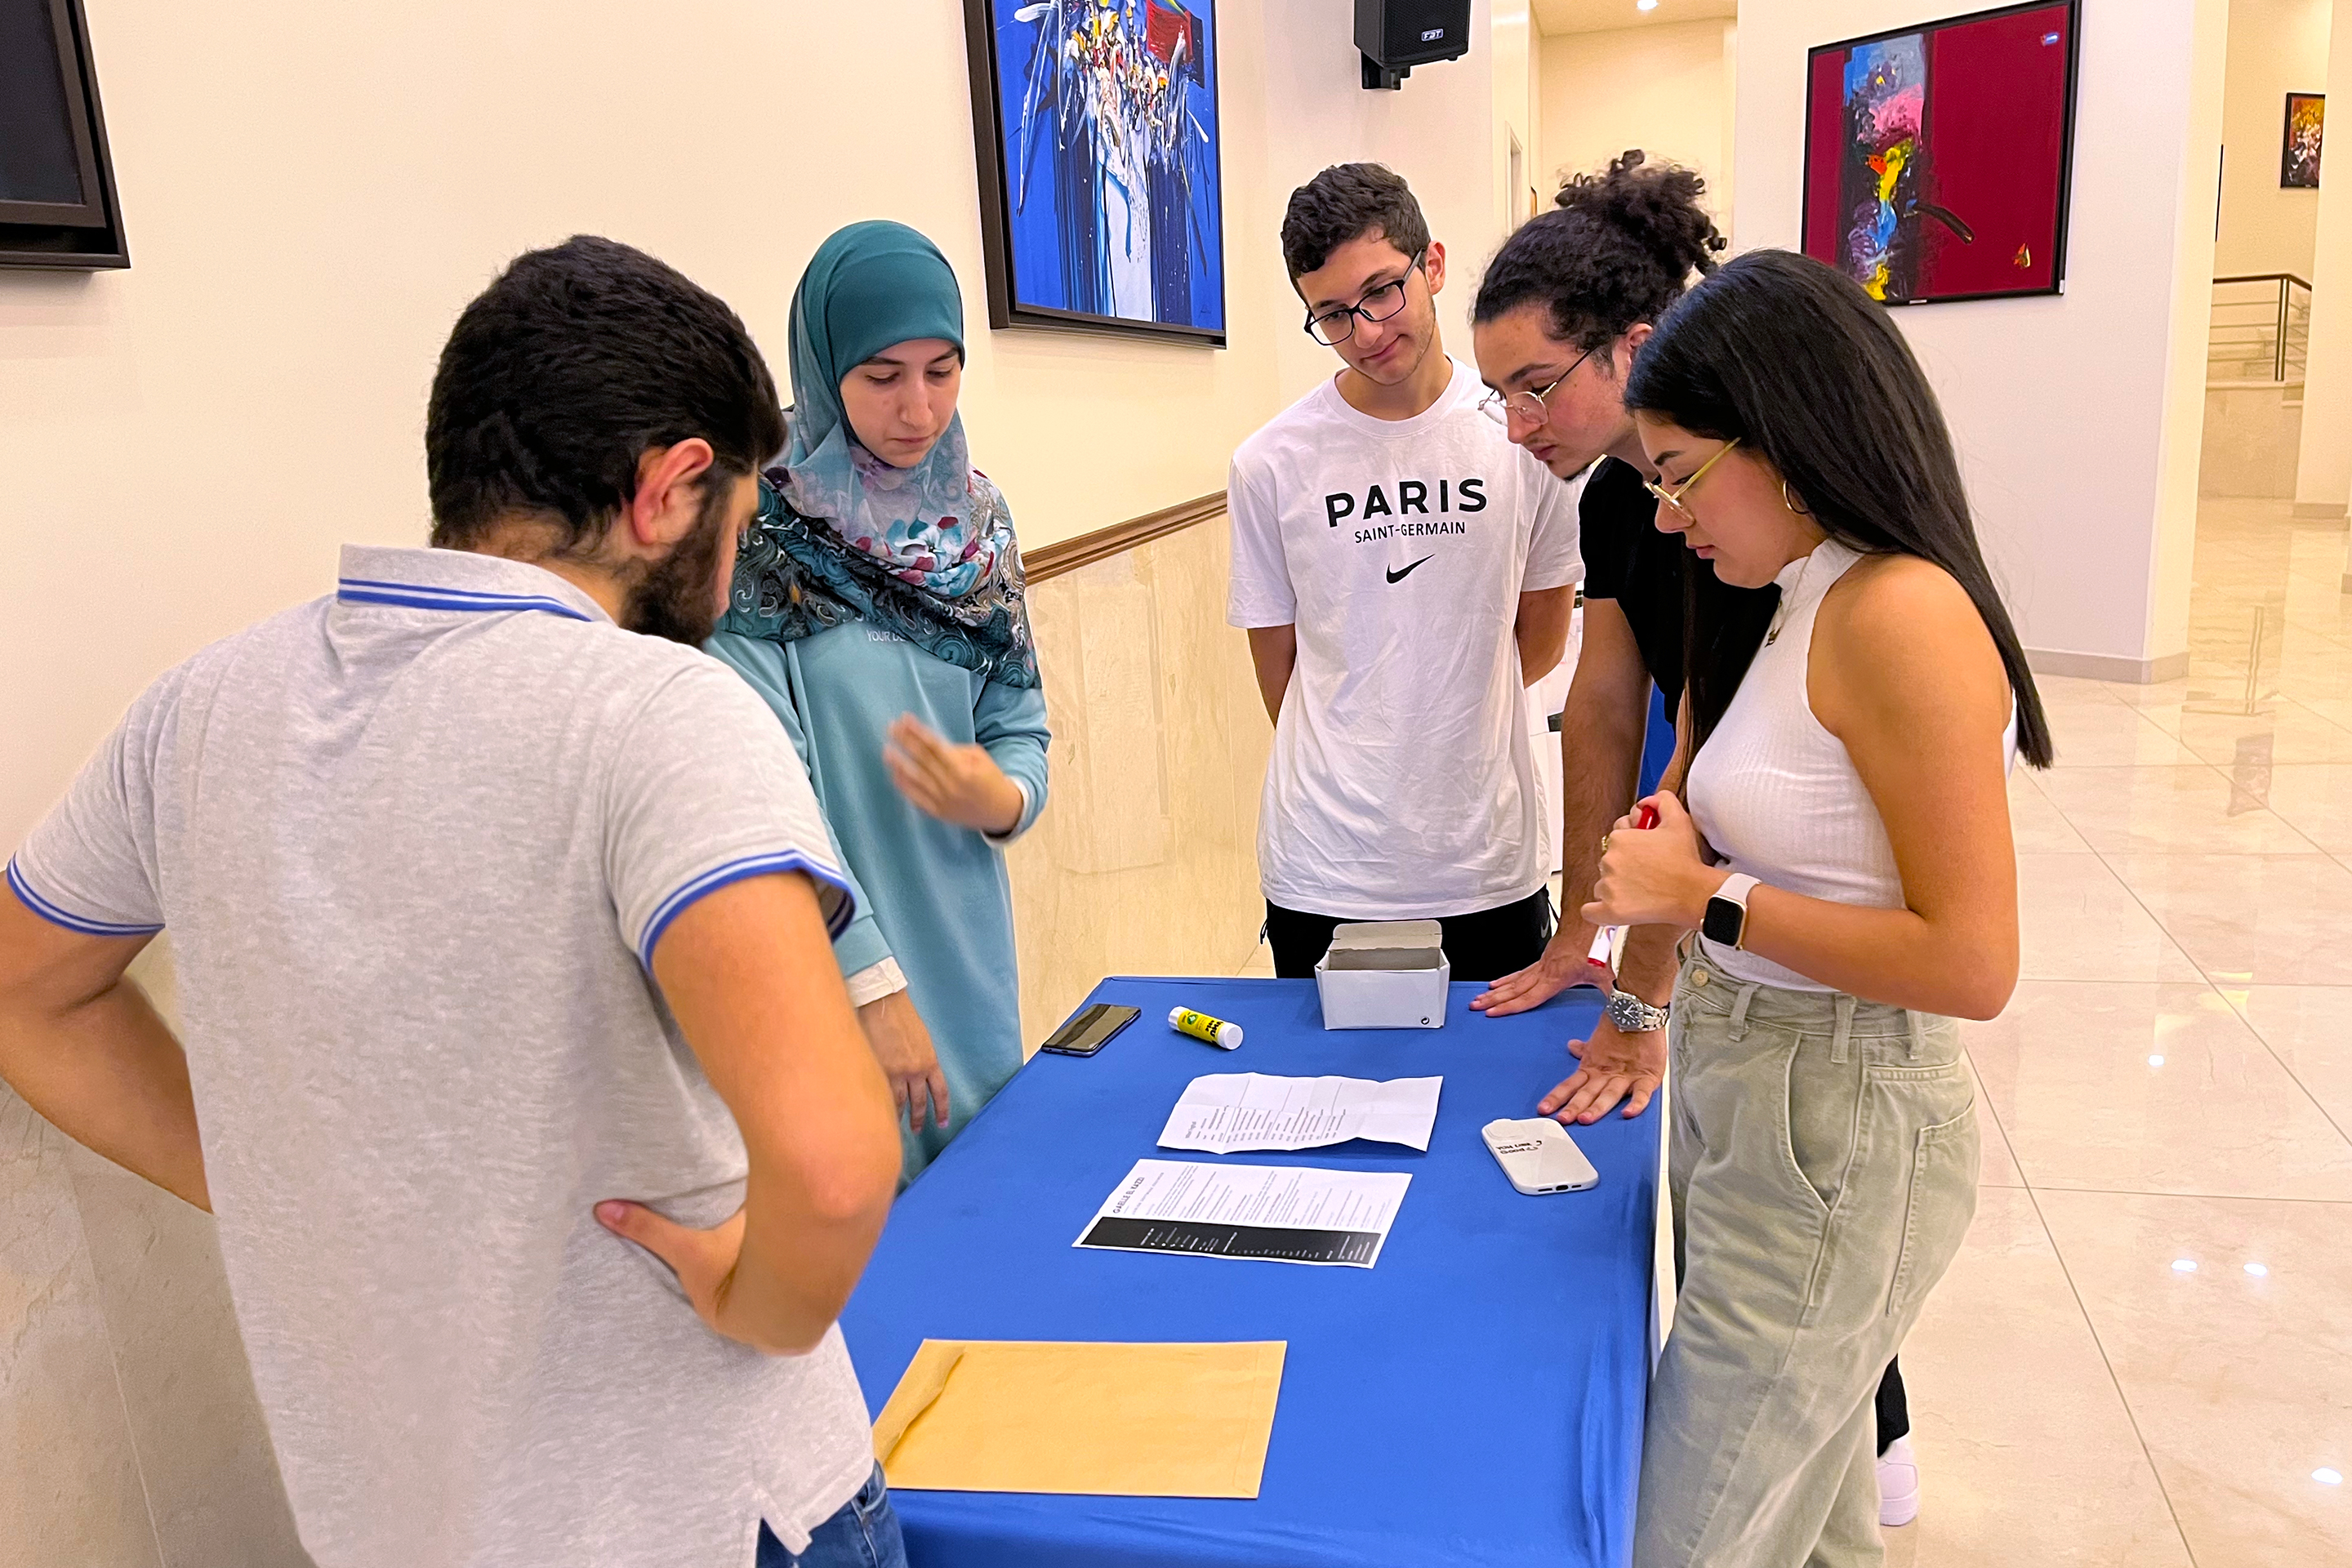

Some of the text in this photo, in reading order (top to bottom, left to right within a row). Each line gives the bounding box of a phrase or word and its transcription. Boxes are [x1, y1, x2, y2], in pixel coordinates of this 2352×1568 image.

[1325, 479, 1487, 528] PARIS
[1354, 521, 1466, 543] SAINT-GERMAIN
[866, 629, 891, 642] YOUR
